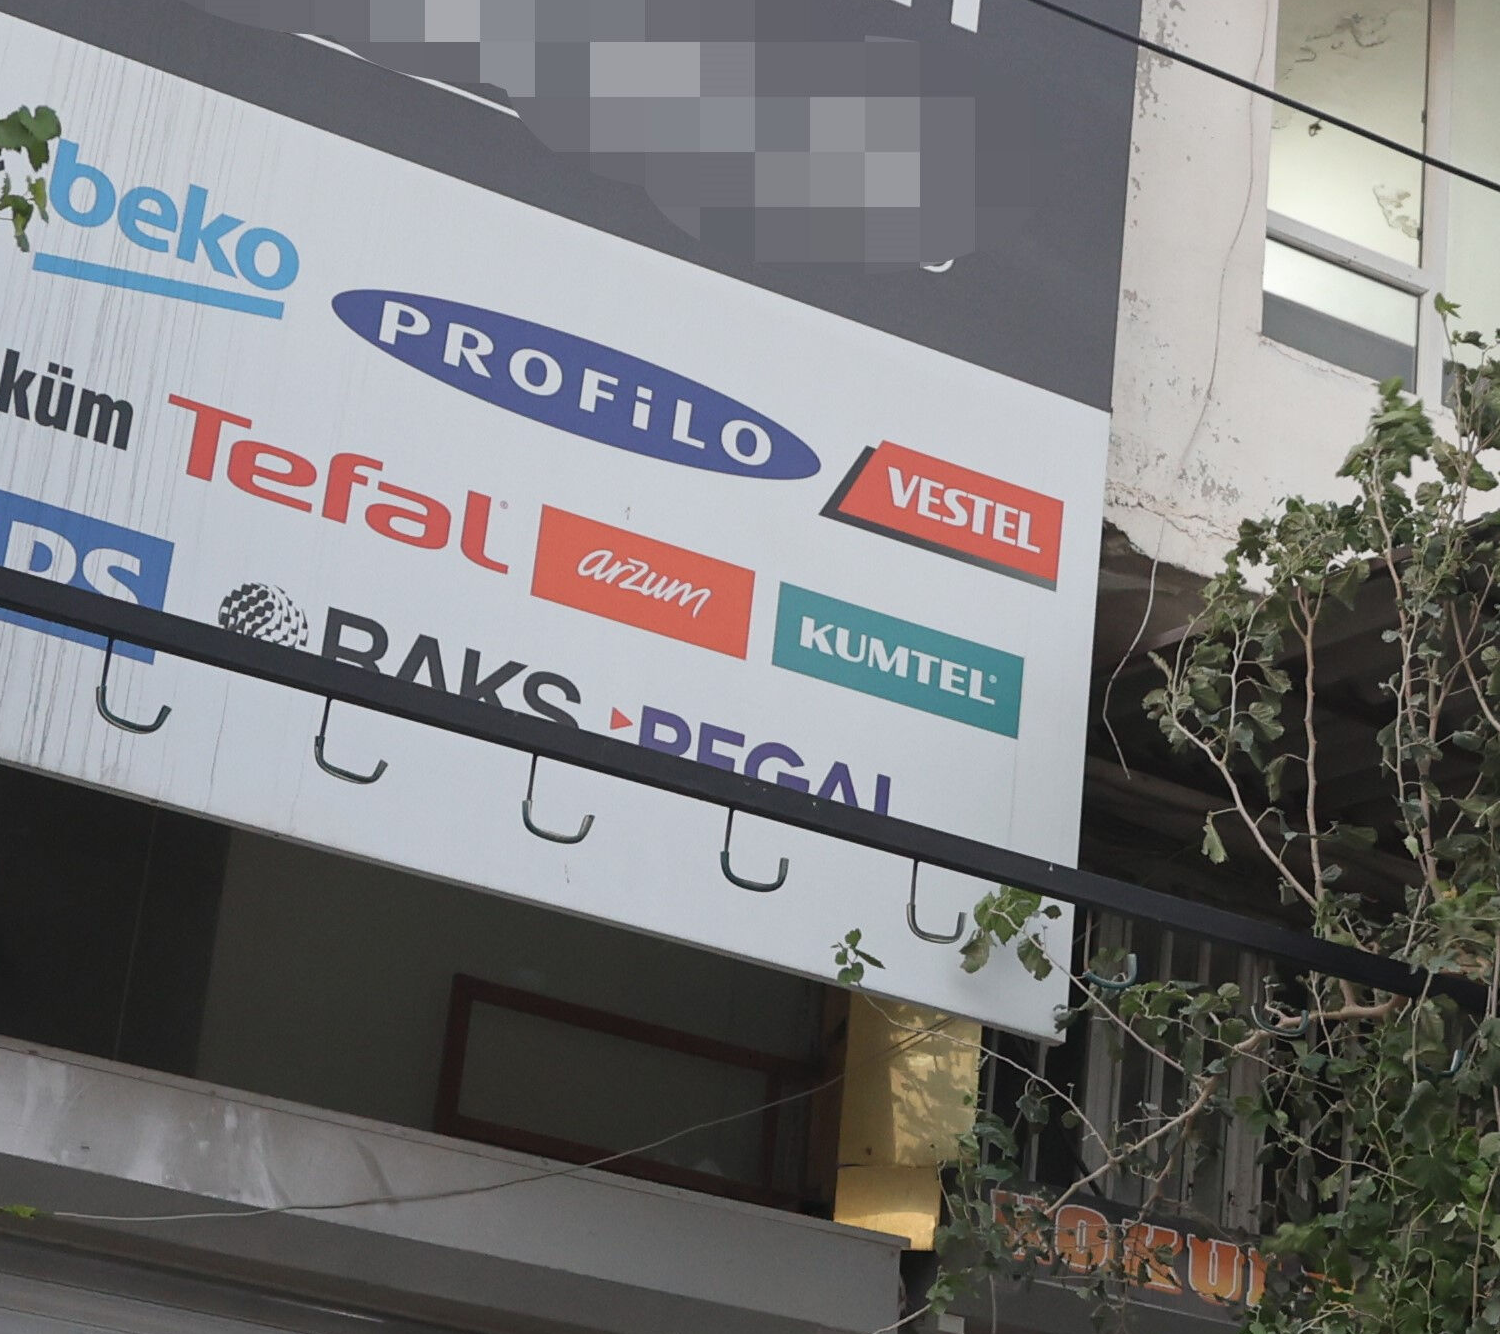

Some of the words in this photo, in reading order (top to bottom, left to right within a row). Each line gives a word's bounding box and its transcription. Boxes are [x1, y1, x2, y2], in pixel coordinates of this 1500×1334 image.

[48, 138, 299, 291] beko
[168, 393, 509, 576] Tefal
[888, 466, 1041, 554] VESTEL
[577, 548, 711, 618] arzum
[800, 615, 997, 705] KUMTEL
